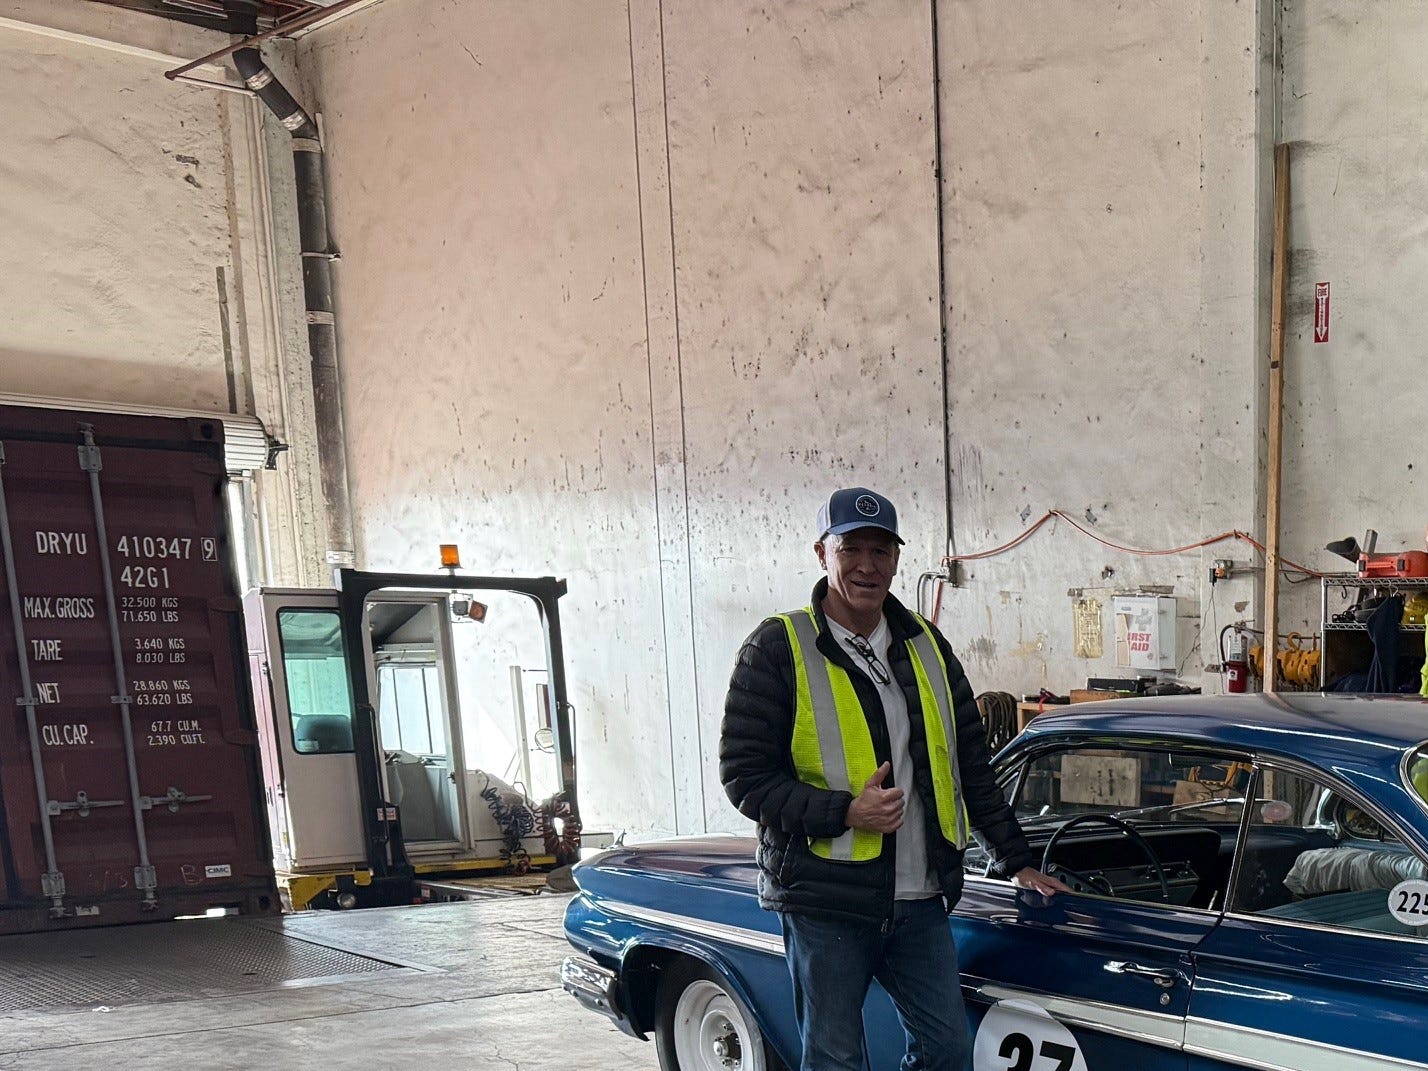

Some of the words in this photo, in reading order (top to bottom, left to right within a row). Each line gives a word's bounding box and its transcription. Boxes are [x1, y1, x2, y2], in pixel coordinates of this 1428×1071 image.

[36, 531, 87, 555] DRYU
[117, 536, 192, 559] 410347
[203, 539, 215, 559] 9
[120, 566, 169, 588] 42G1
[24, 597, 94, 618] MAX.GROSS
[122, 597, 156, 607] 32.500
[162, 597, 178, 607] KGS
[122, 611, 157, 622] 71.650
[162, 611, 179, 622] LBS
[31, 640, 63, 660] TARE
[134, 639, 163, 649] 3.640
[168, 639, 185, 649] KGS
[136, 653, 164, 663] 8.030
[169, 653, 186, 663] LBS
[1131, 643, 1149, 652] AID
[36, 682, 60, 703] NET
[133, 681, 168, 690] 28.860
[173, 680, 190, 690] KGS
[137, 694, 171, 704] 63.620
[177, 694, 193, 704] LBS
[42, 724, 94, 745] CU.CAP.
[151, 721, 171, 732] 67.7
[148, 735, 176, 745] 2.390
